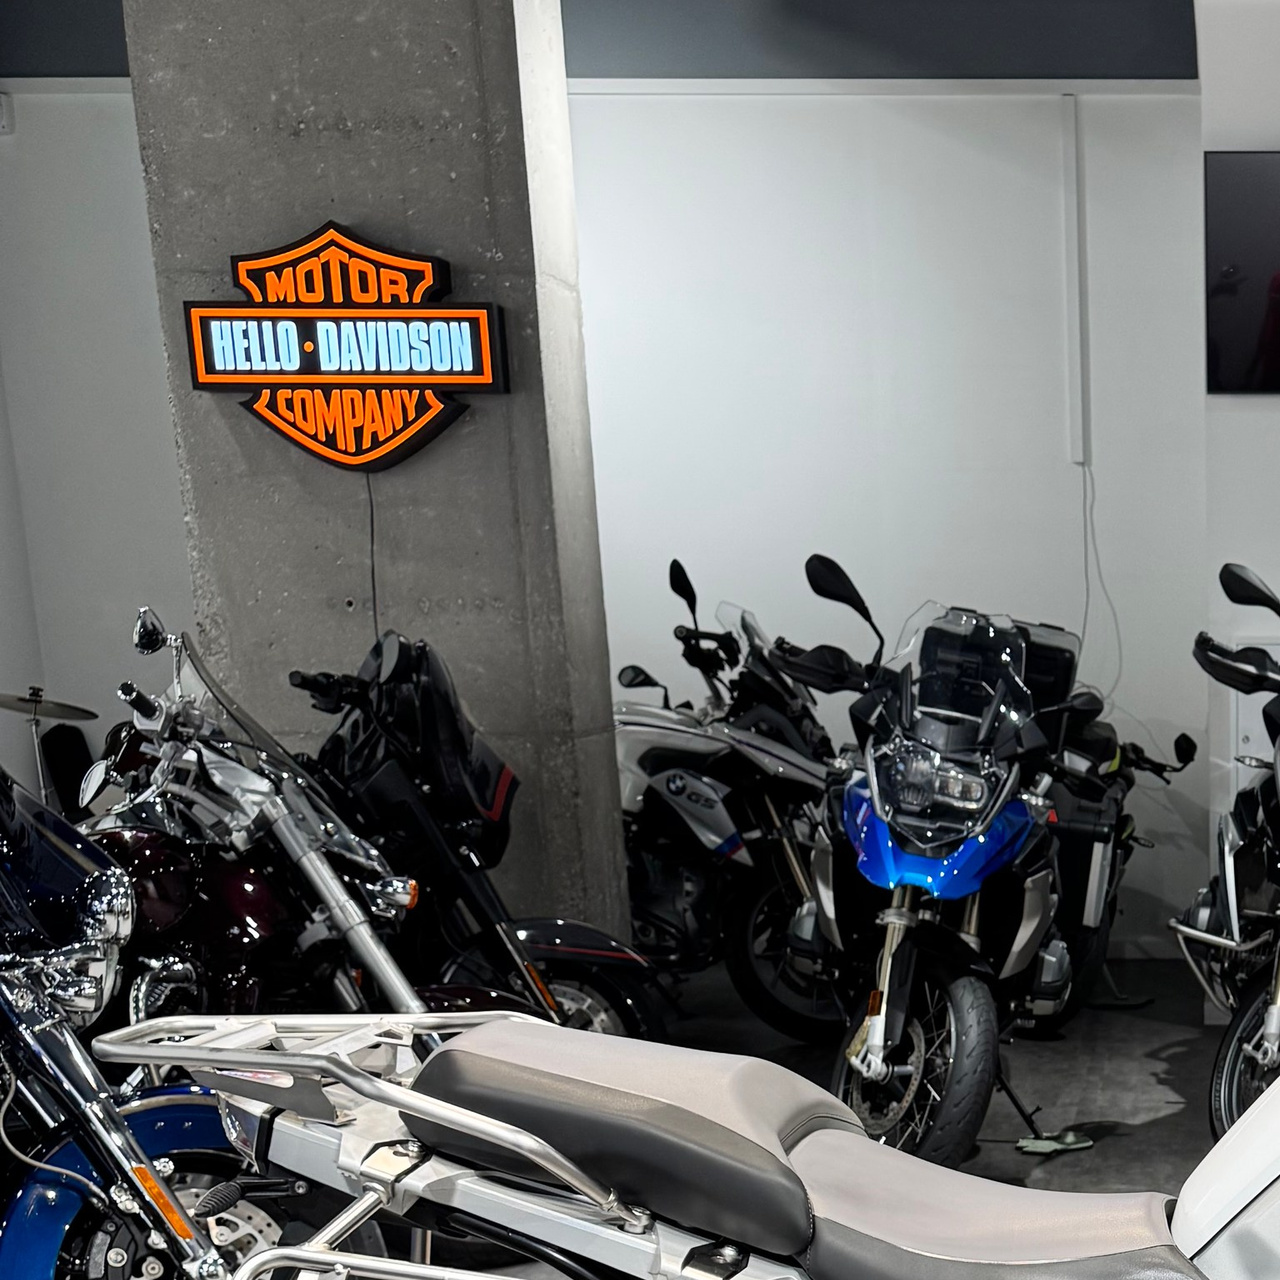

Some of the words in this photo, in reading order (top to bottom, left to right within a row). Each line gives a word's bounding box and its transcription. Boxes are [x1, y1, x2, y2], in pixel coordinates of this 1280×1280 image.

[265, 245, 410, 304] MOTOR
[210, 320, 300, 371] HELLO
[316, 320, 473, 371] DAVIDSON
[276, 388, 420, 453] COMPANY
[687, 791, 720, 810] GS
